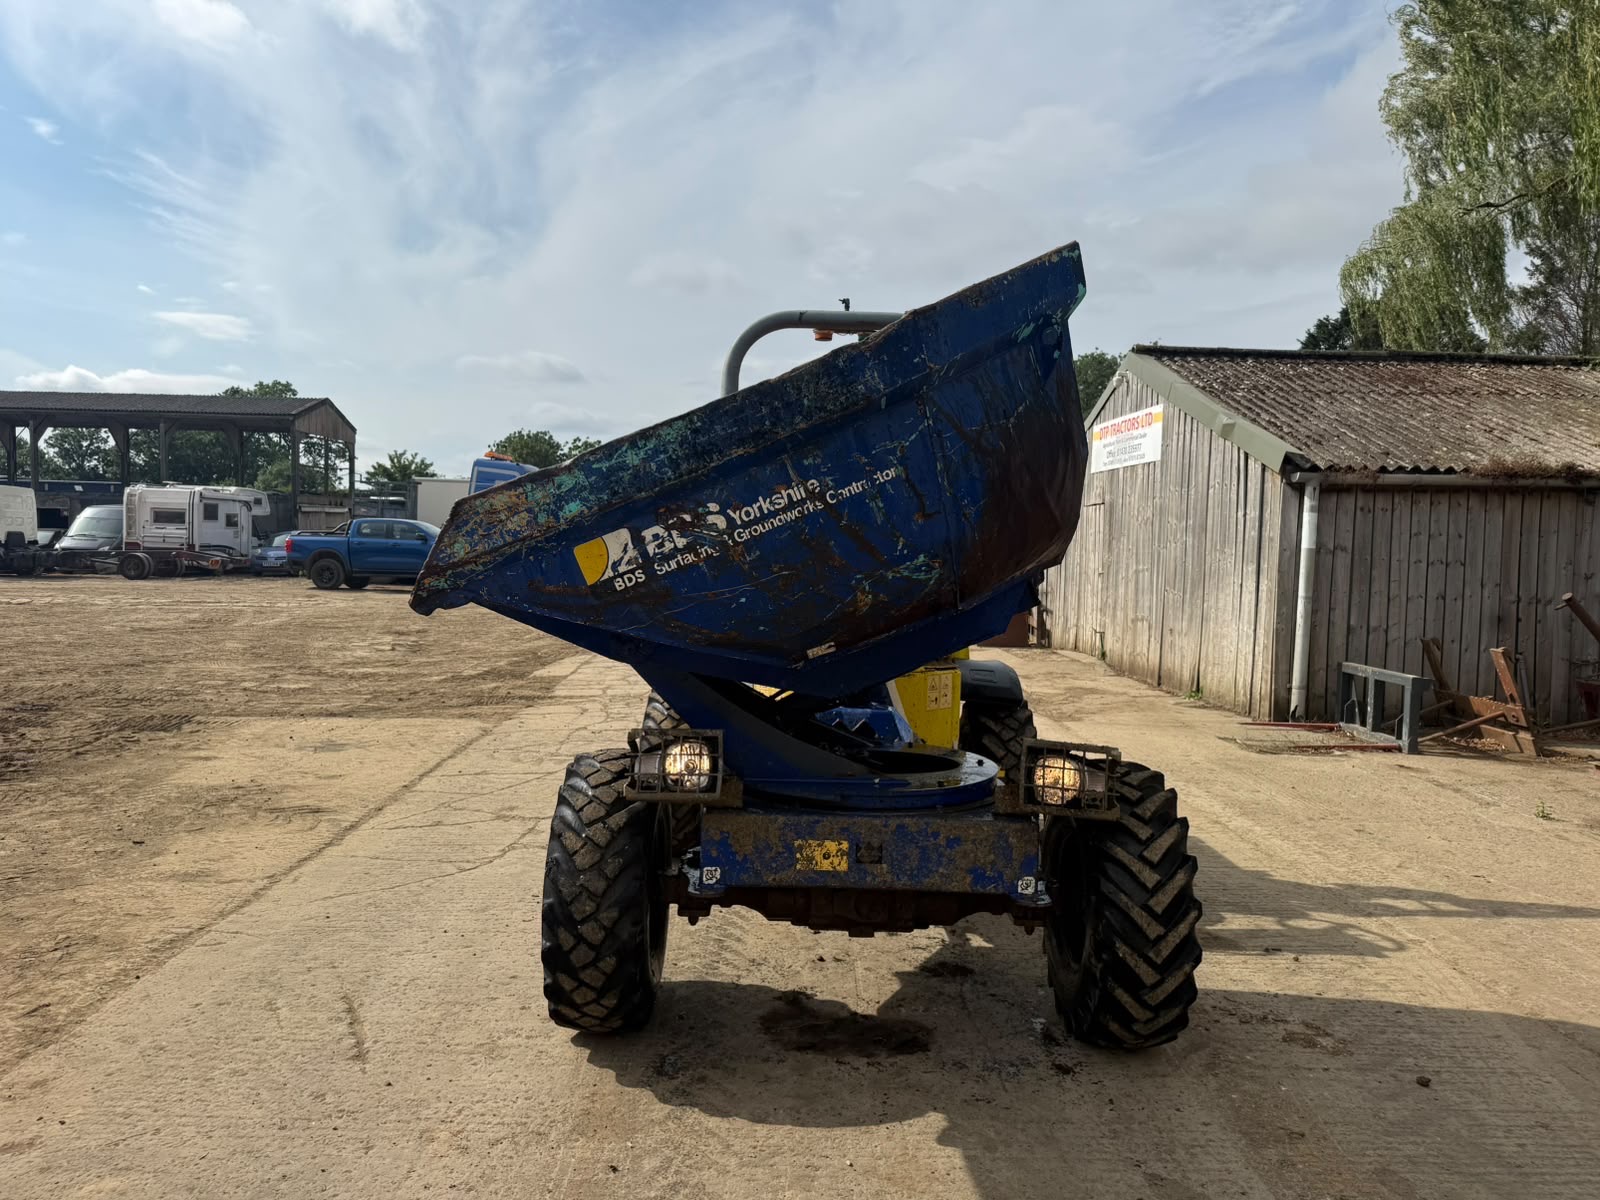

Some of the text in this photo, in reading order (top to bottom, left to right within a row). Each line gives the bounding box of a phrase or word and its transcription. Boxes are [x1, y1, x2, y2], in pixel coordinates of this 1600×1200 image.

[1110, 415, 1140, 437] TRACTORS
[1141, 411, 1154, 429] LTD
[727, 479, 821, 525] Yorkshire
[614, 569, 646, 592] BDS
[734, 499, 824, 543] Groundworks
